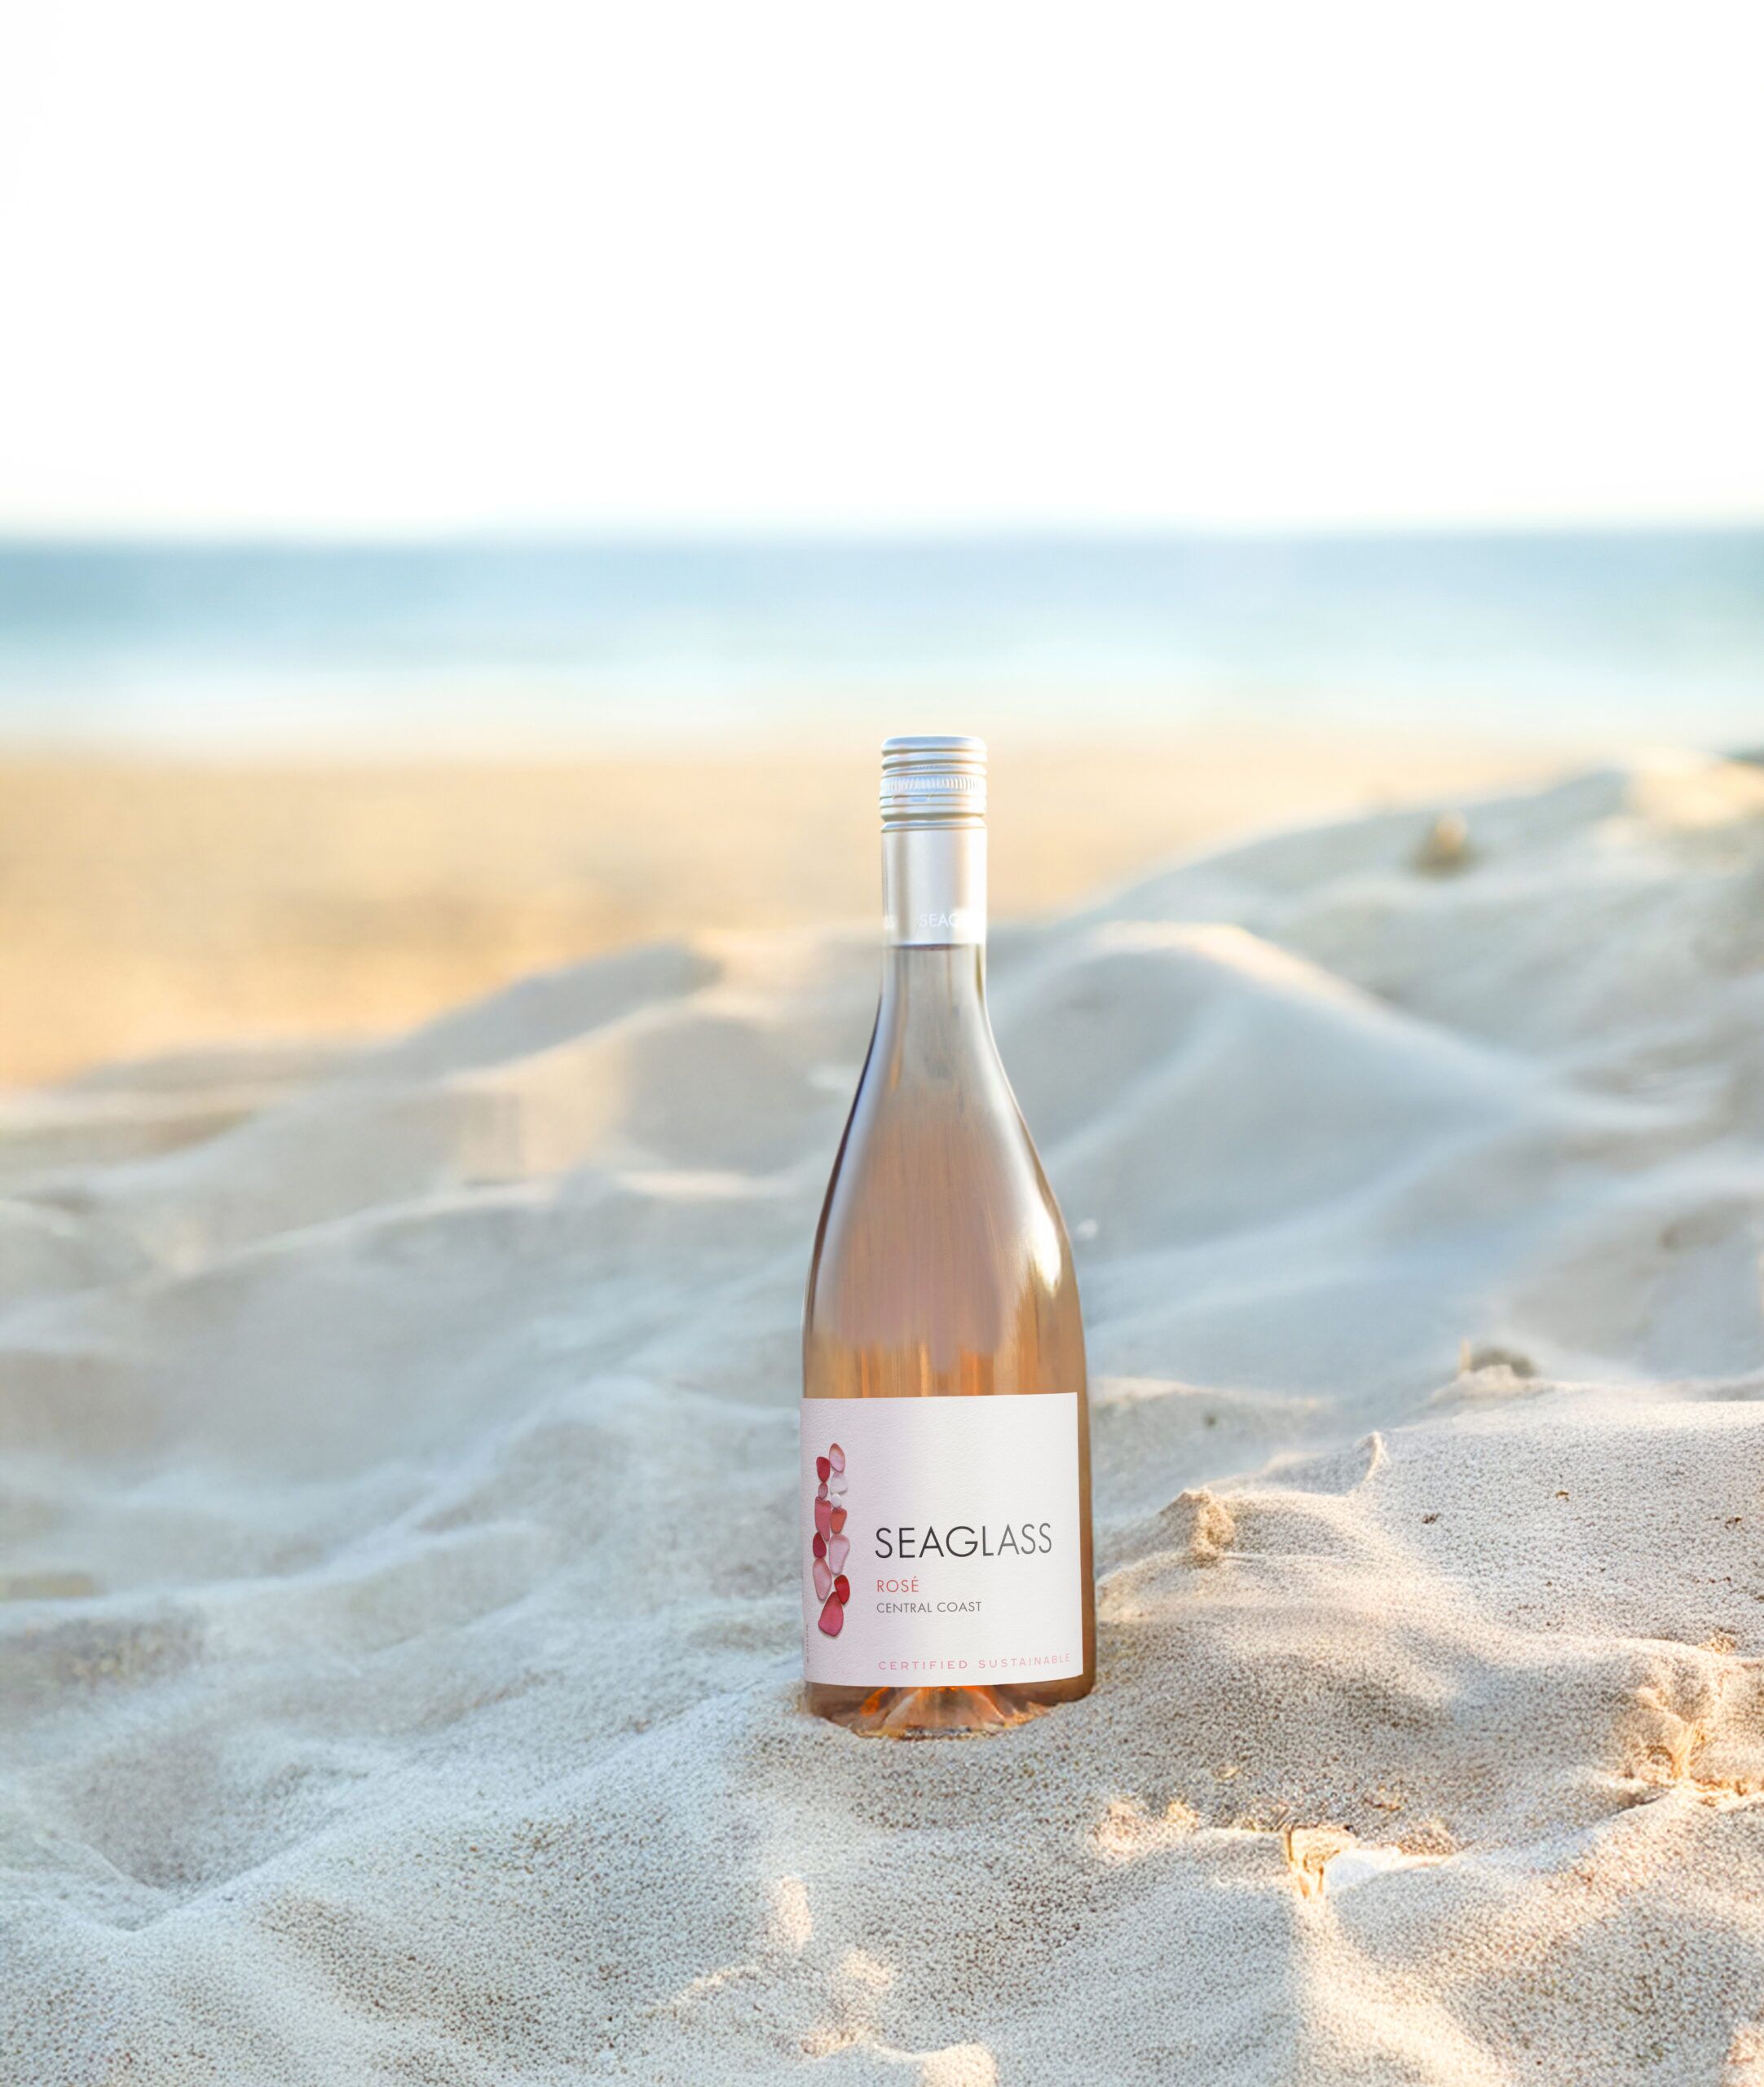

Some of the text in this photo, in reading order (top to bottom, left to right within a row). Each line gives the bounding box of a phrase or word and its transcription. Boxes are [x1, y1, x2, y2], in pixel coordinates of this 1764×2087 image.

[919, 912, 959, 928] SEAG
[875, 1522, 1052, 1559] SEAGLASS
[876, 1575, 919, 1593] ROSÉ
[876, 1600, 982, 1613] CENTRAL COAST
[878, 1653, 1070, 1670] CERTIFIED SUSTAINABLE
